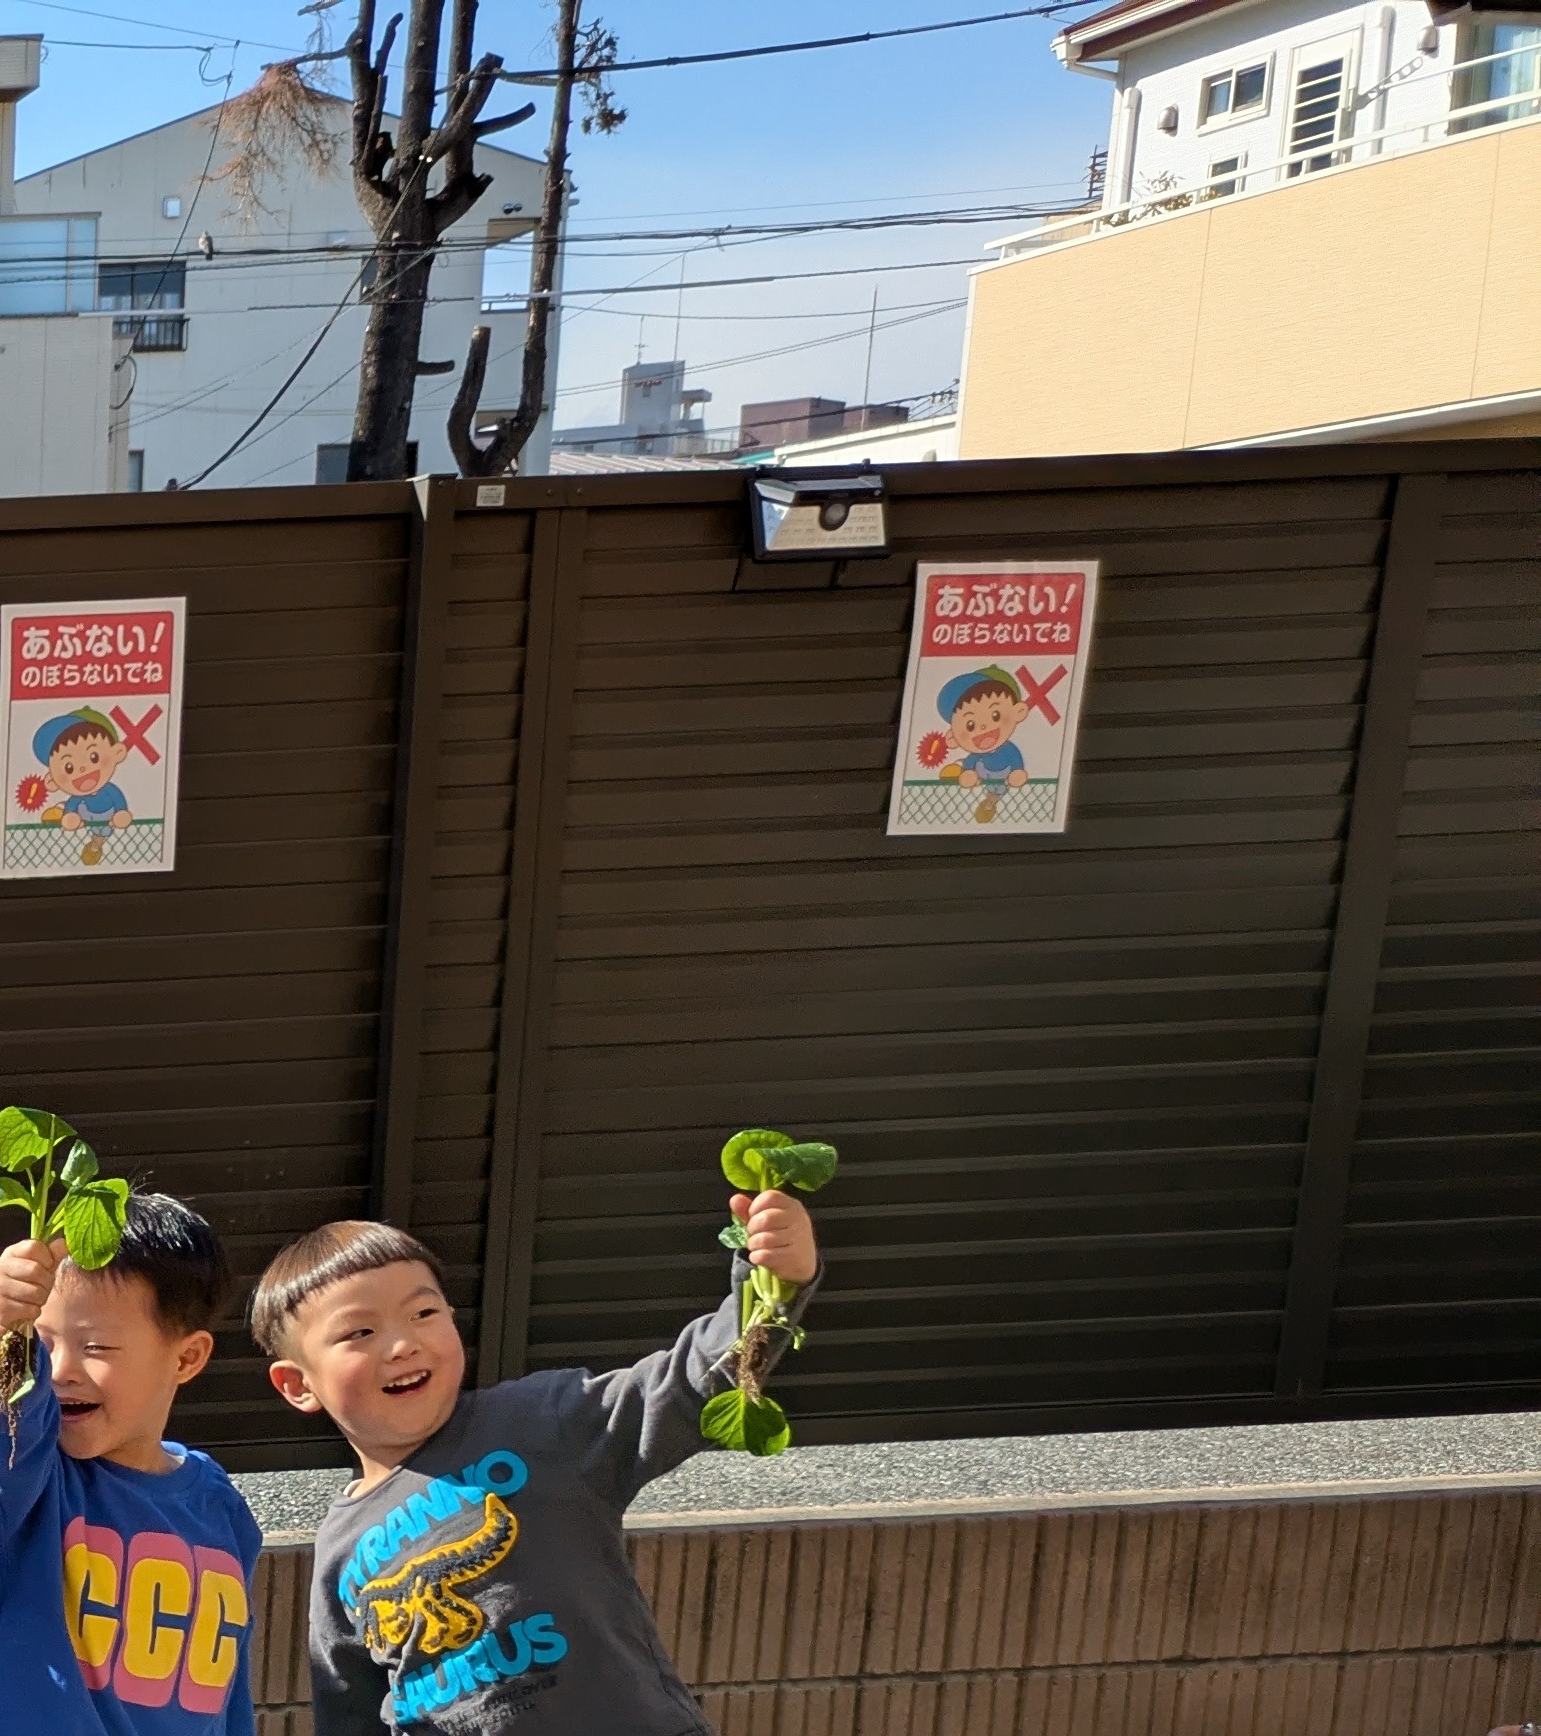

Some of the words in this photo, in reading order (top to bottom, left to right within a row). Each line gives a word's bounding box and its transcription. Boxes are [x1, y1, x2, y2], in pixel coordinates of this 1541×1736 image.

[934, 583, 1077, 617] あぶない!
[21, 621, 166, 660] あぶない!
[932, 621, 1072, 645] のぼらないでね
[21, 661, 163, 688] のぼらないでね
[338, 1449, 529, 1610] TYRANNO
[64, 1530, 248, 1700] CCC
